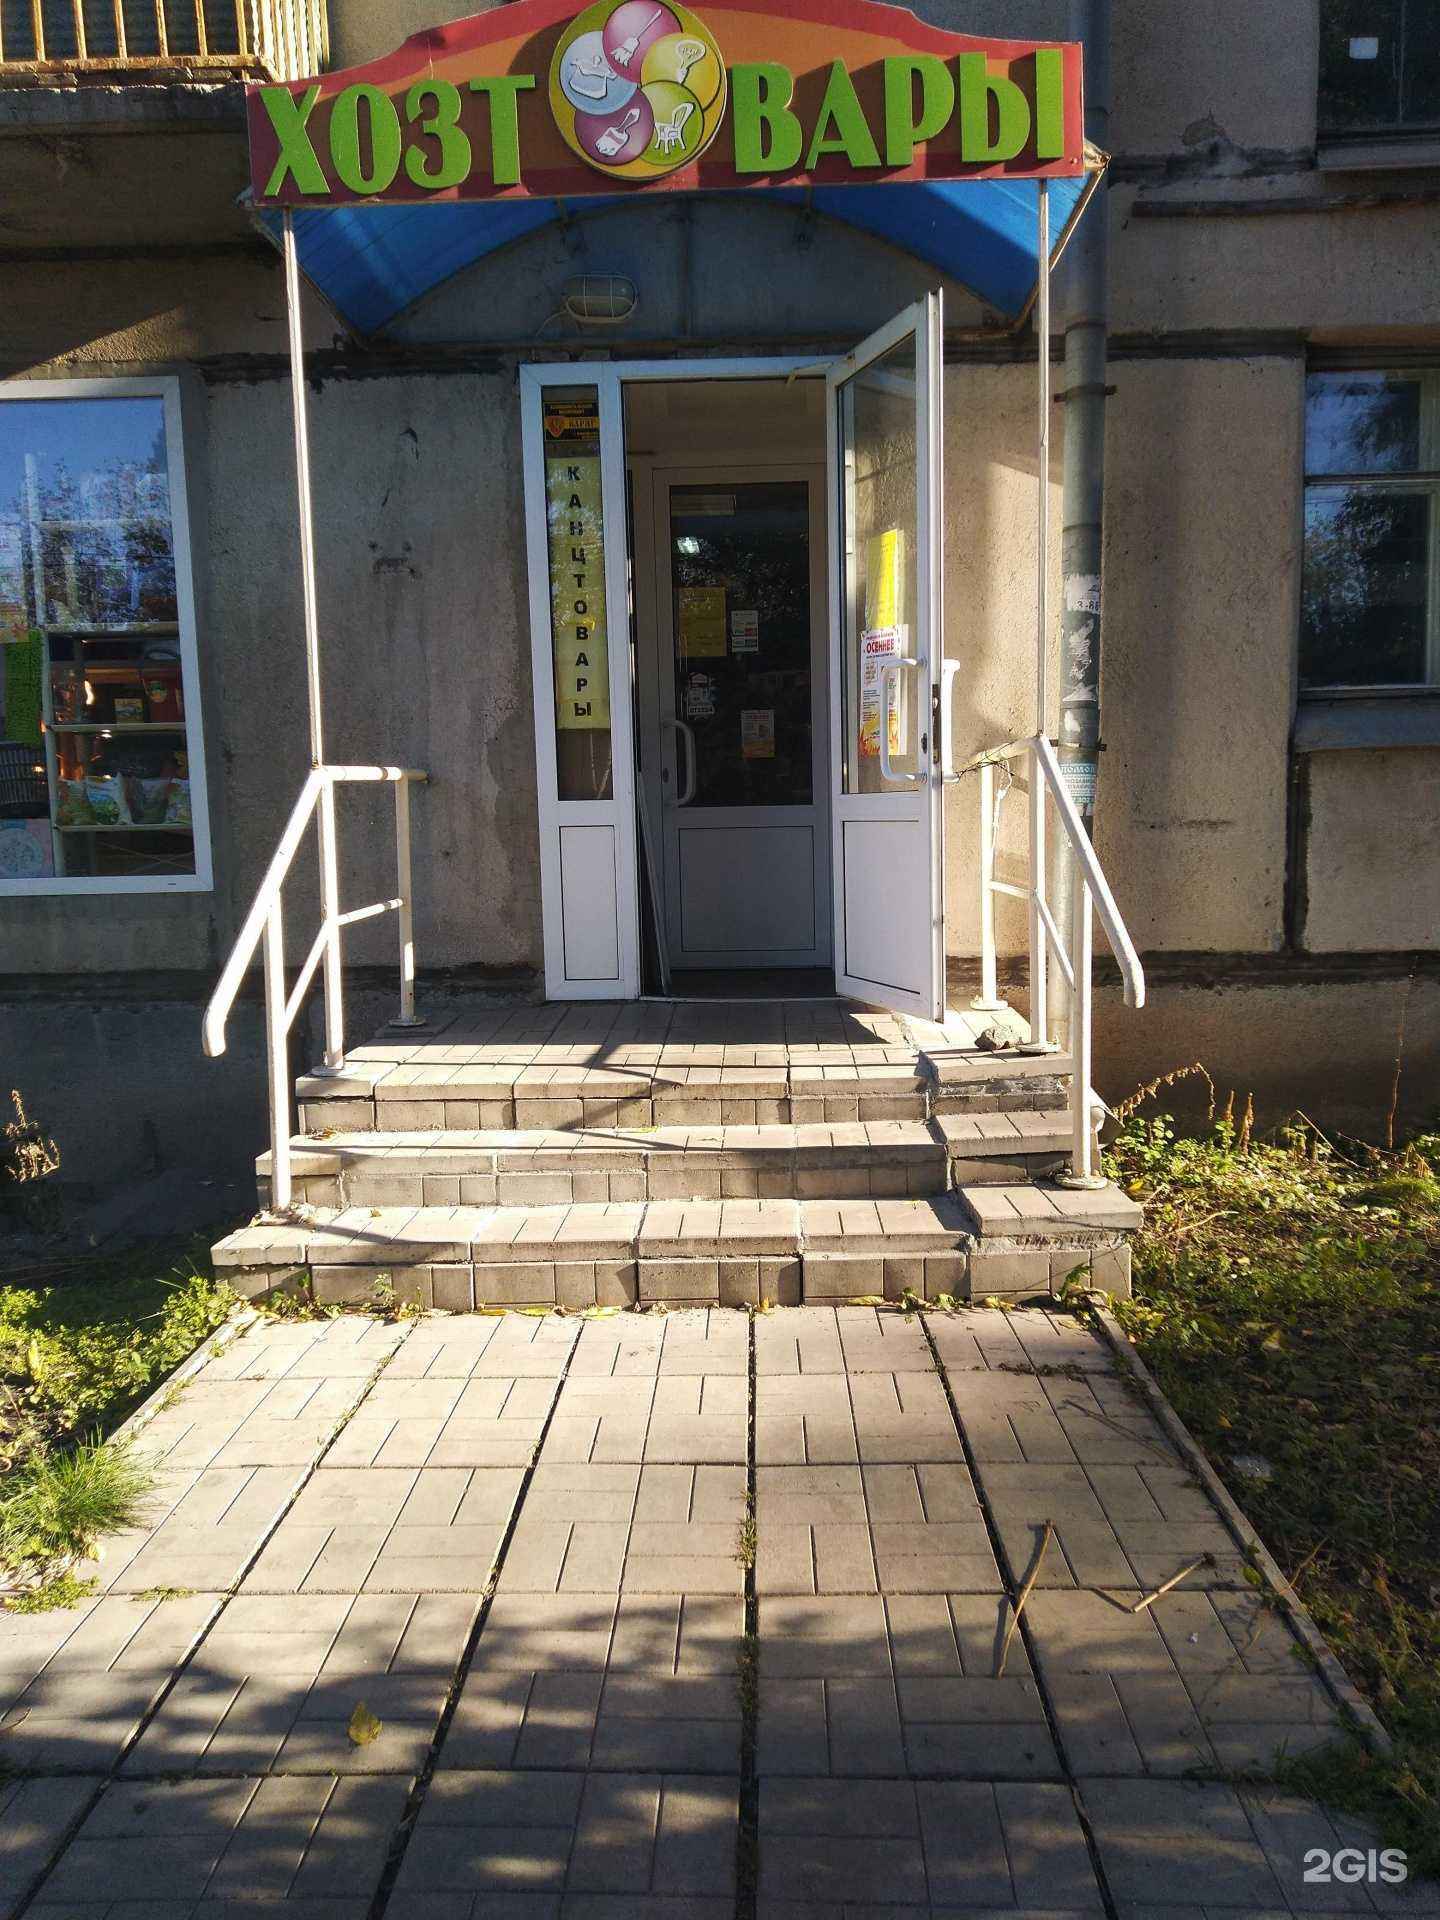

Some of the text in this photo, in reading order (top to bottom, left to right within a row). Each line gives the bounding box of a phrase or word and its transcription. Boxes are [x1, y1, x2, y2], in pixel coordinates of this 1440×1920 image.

[259, 49, 1064, 197] ХОЗТ ВАРЫ
[567, 466, 592, 717] КАНЦТОВАРЫ
